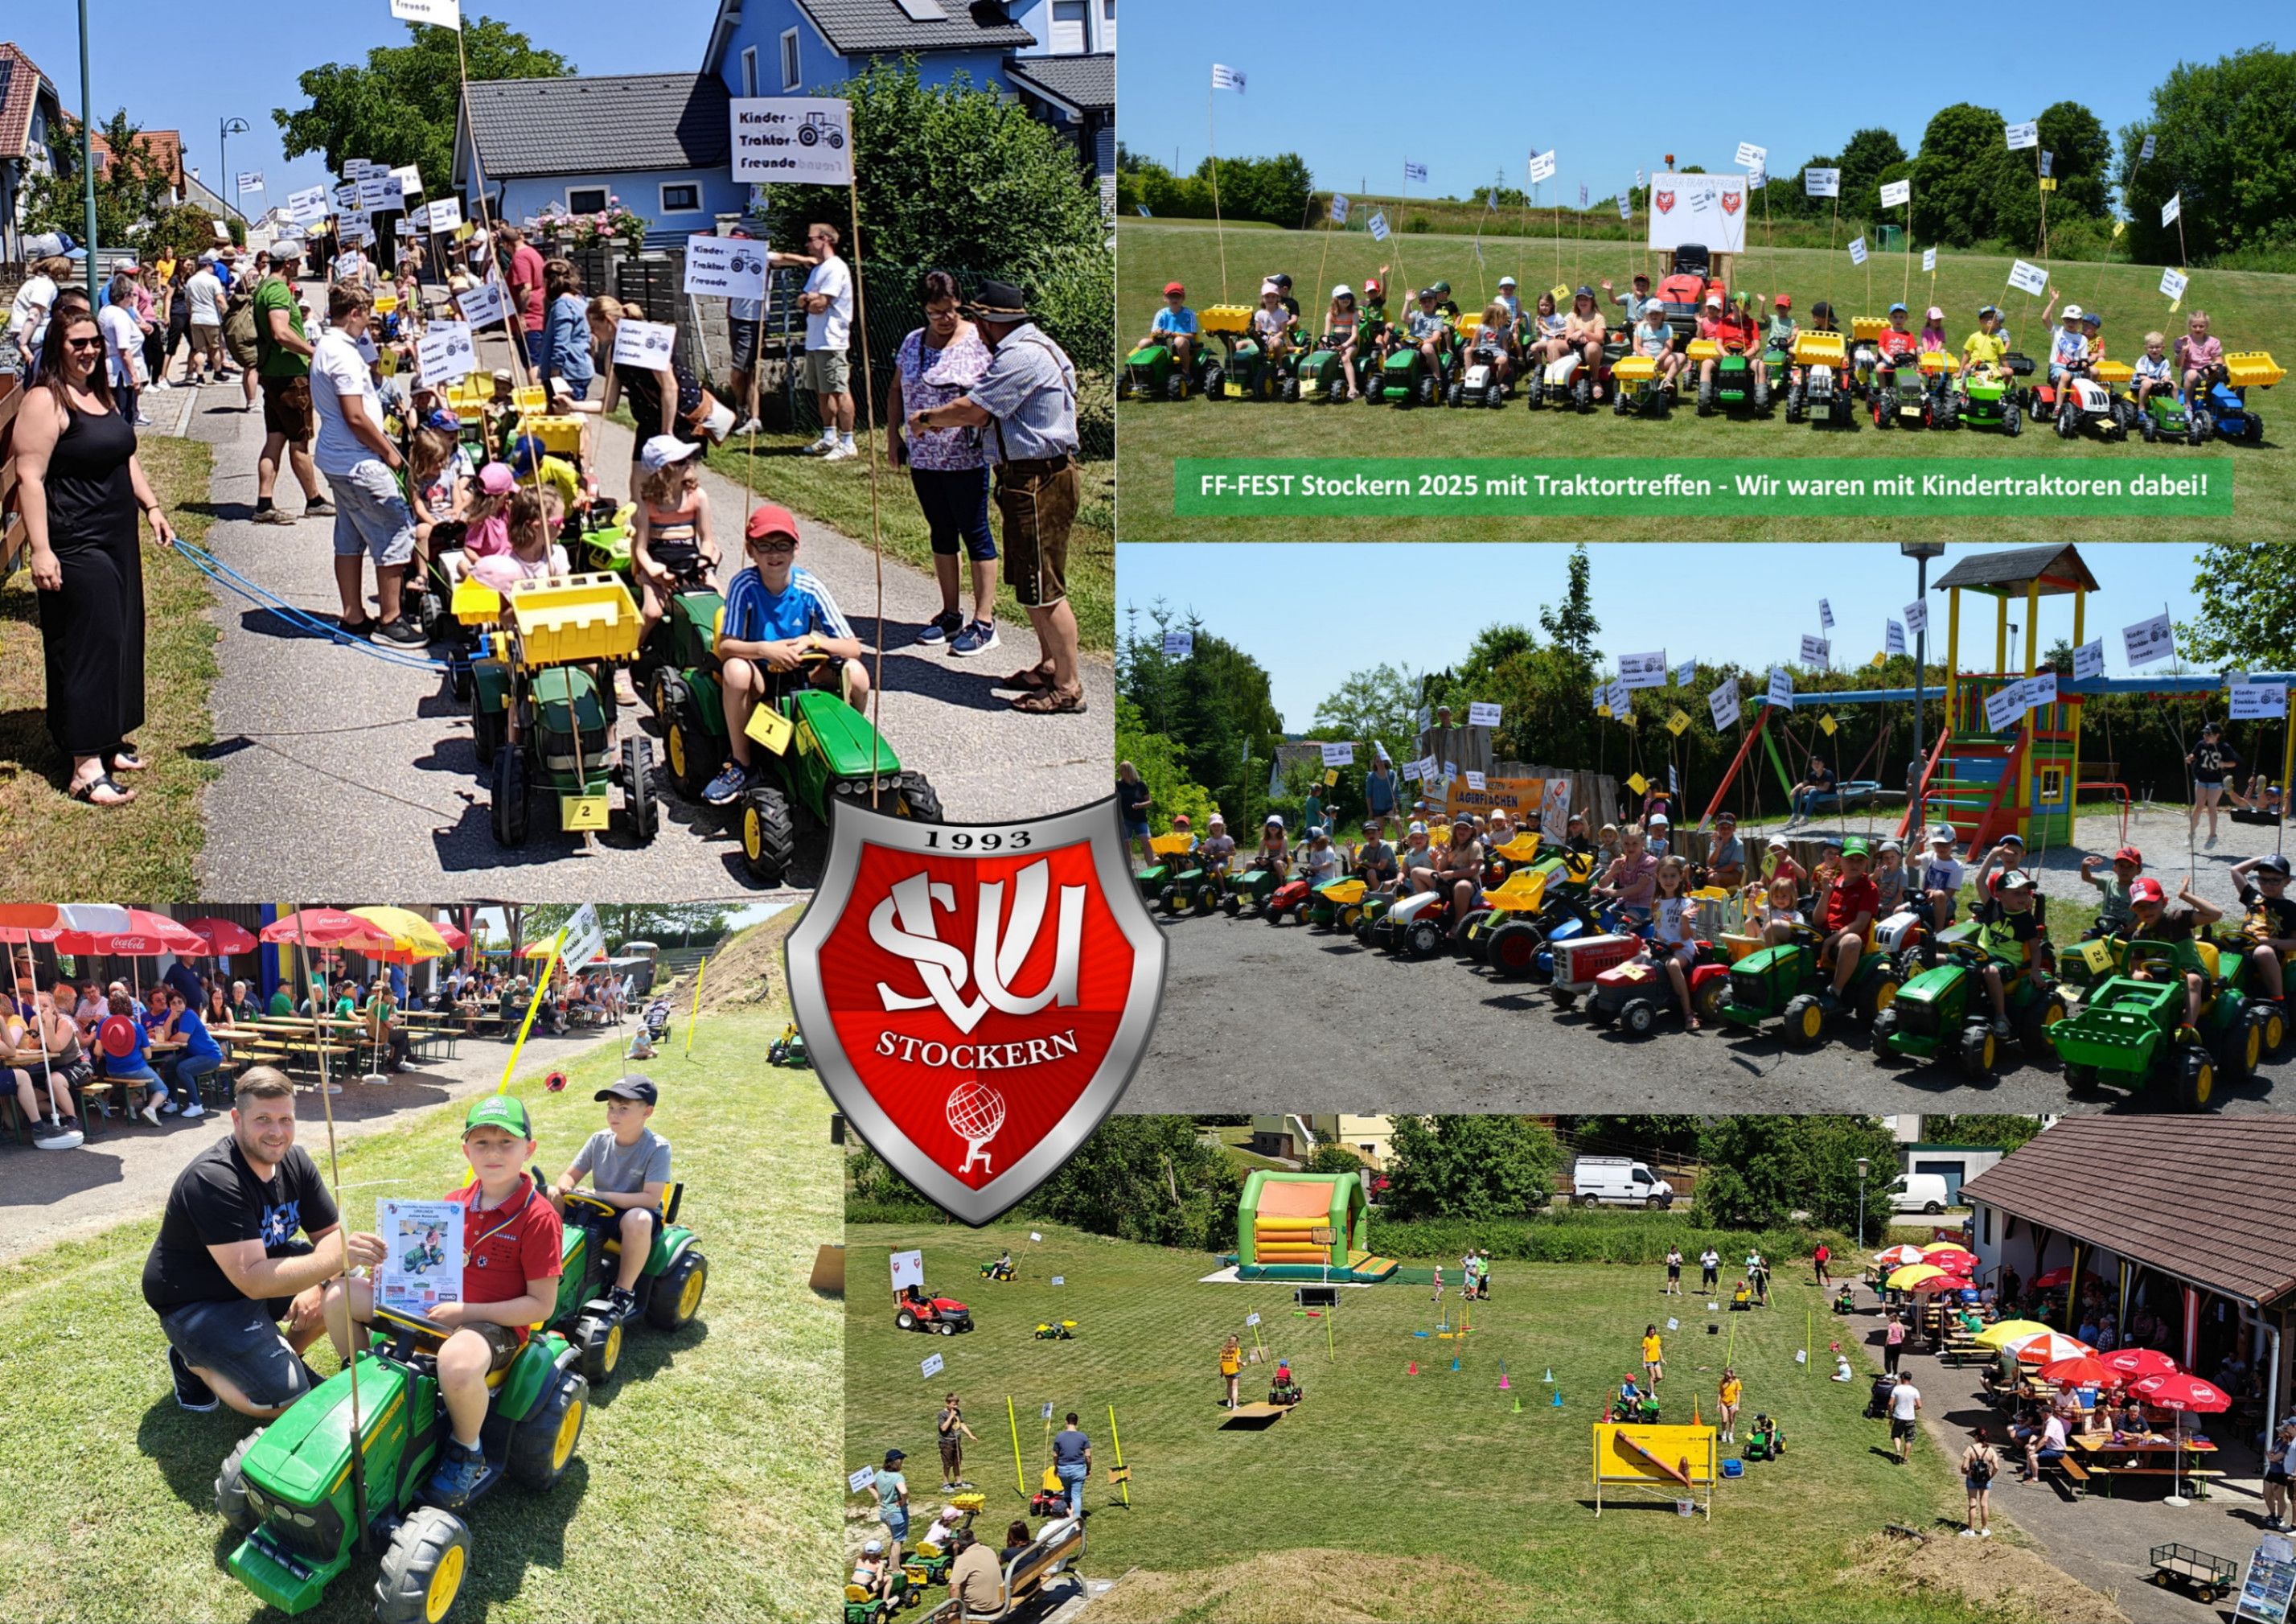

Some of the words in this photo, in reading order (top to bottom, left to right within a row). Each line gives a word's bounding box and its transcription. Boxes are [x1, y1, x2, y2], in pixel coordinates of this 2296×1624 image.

[740, 158, 796, 169] Freunde
[765, 724, 774, 735] 1
[581, 805, 591, 817] 2
[2092, 949, 2104, 964] 22
